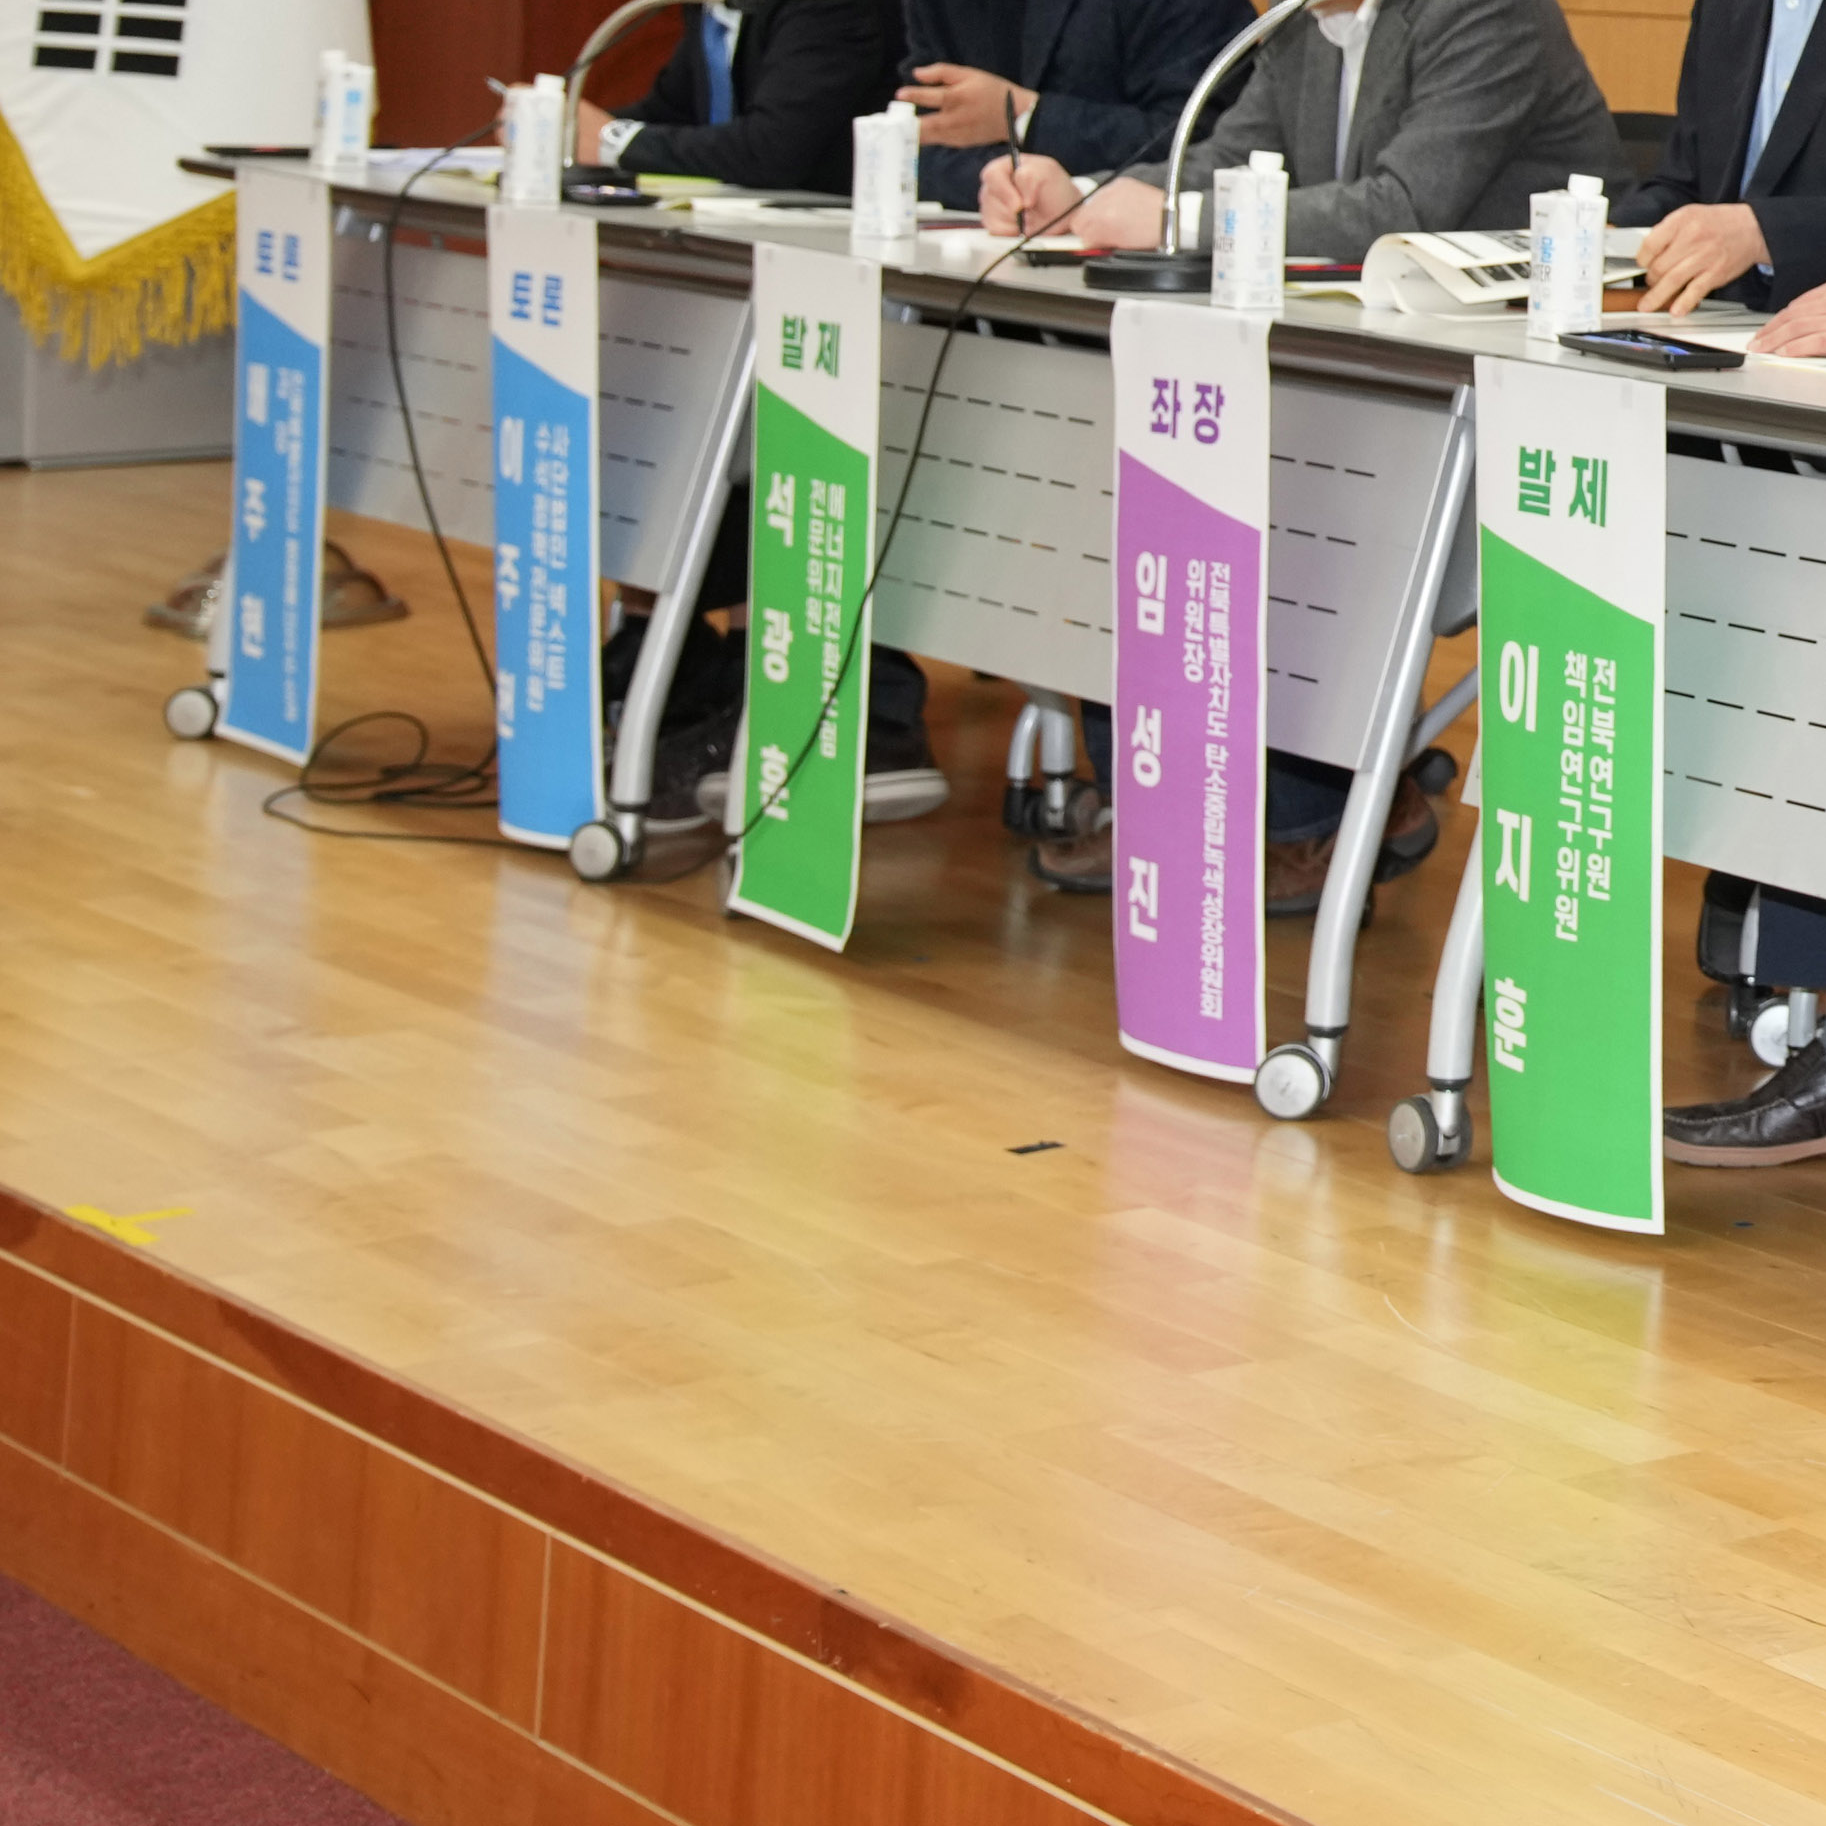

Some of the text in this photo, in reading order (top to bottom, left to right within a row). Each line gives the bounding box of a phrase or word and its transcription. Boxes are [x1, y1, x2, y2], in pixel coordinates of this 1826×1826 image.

[509, 271, 563, 328] 토론
[779, 314, 840, 378] 발제
[1150, 377, 1226, 445] 좌장
[1517, 445, 1608, 527] 발제
[805, 478, 827, 637] 전문위원
[1182, 558, 1207, 684] 위원장
[1205, 560, 1233, 739] 전북특별자치도
[1128, 550, 1169, 944] 임성진
[1553, 649, 1588, 943] 책임연구위원
[1585, 654, 1617, 902] 전북연구원
[1493, 640, 1539, 1074] 이지훈
